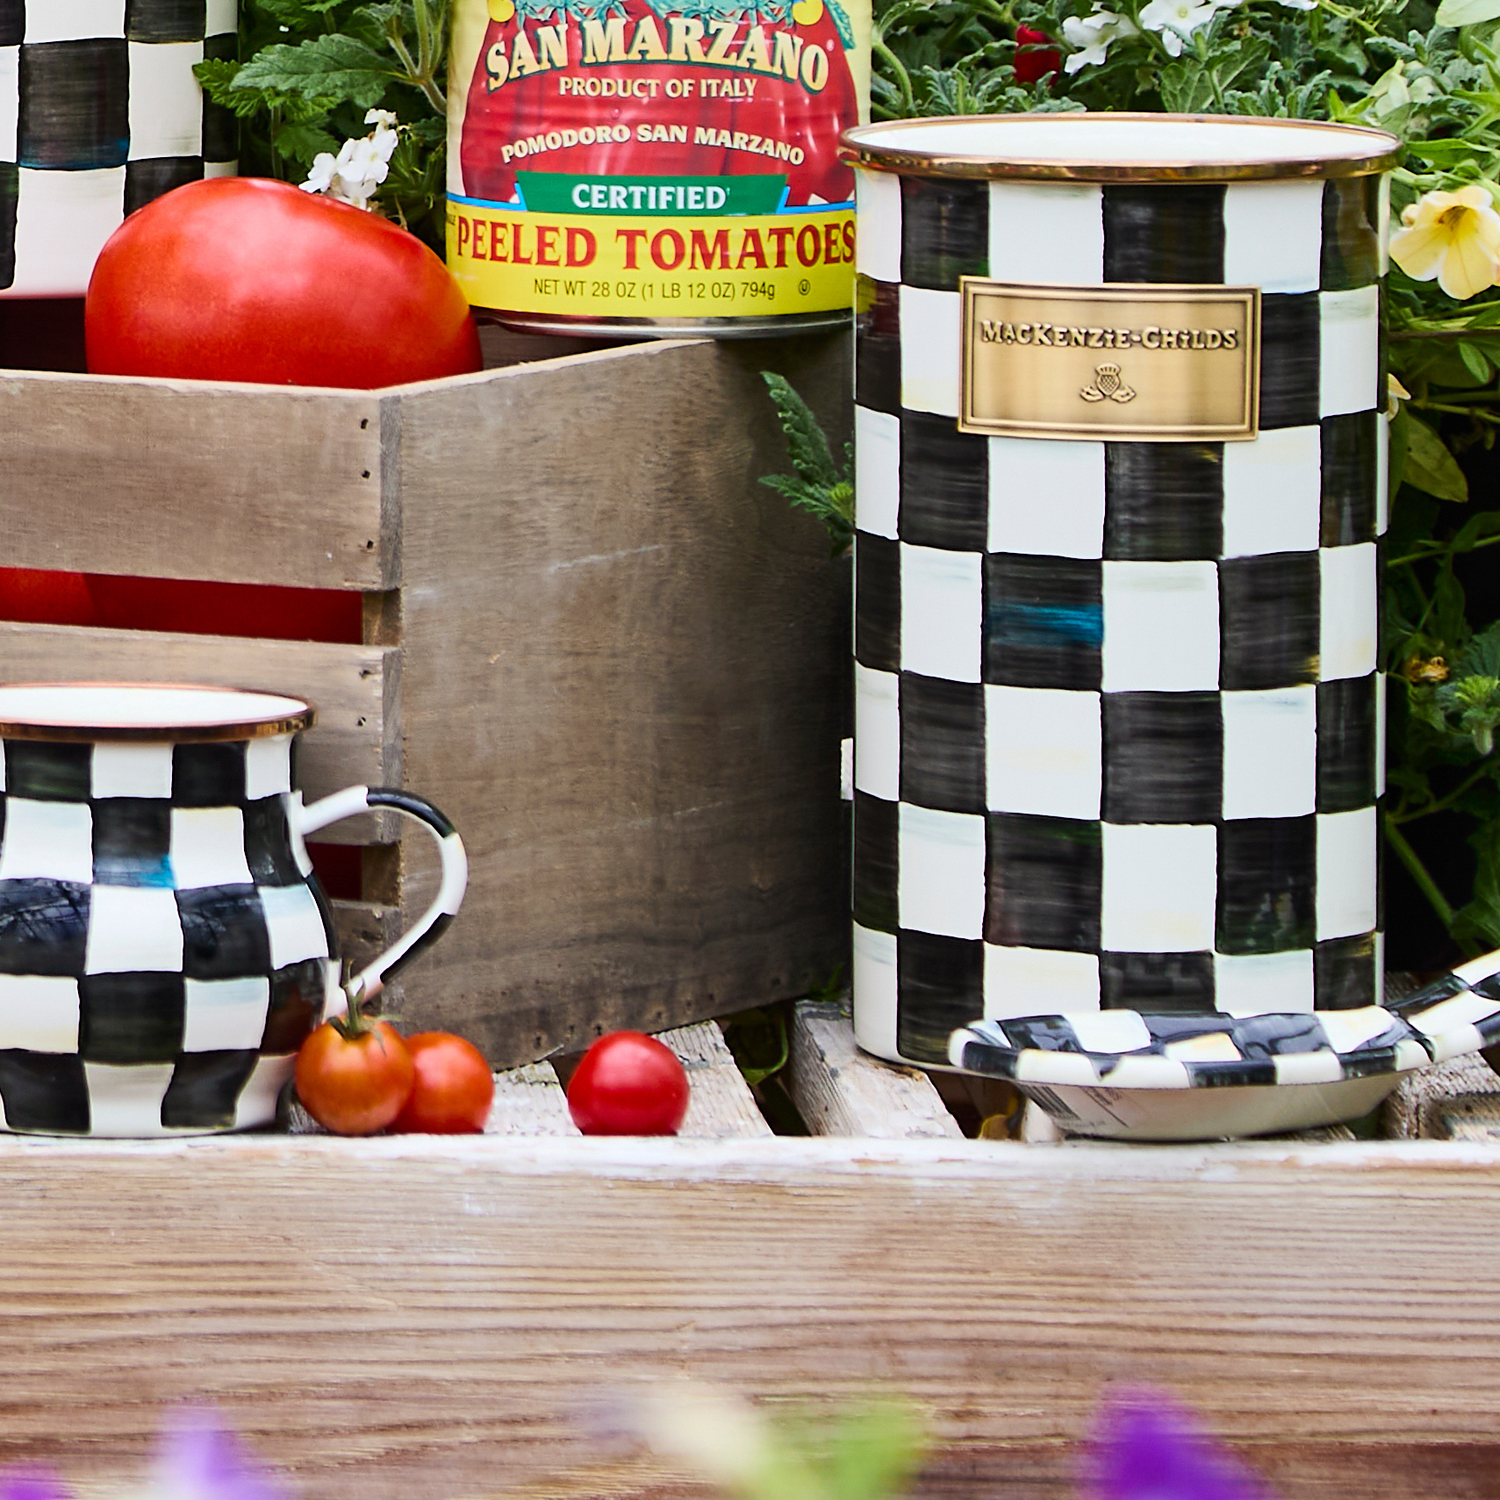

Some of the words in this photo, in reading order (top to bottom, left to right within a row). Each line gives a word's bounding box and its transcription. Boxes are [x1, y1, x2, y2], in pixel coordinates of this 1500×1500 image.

[486, 23, 569, 95] SAN
[580, 15, 830, 95] MARZANO
[559, 76, 661, 98] PRODUCT
[665, 78, 696, 98] OF
[700, 78, 758, 98] ITALY
[501, 124, 631, 164] POMODORO
[636, 123, 688, 143] SAN
[694, 126, 805, 166] MARZANO
[457, 215, 598, 268] PEELED
[615, 219, 856, 271] TOMATOES
[534, 278, 560, 295] NET
[564, 280, 587, 297] WT
[592, 281, 611, 298] 28
[616, 281, 637, 299] OZ
[641, 283, 655, 301] (1
[661, 283, 682, 299] LB
[688, 283, 706, 299] 12
[711, 282, 736, 301] OZ)
[741, 281, 776, 301] 794g
